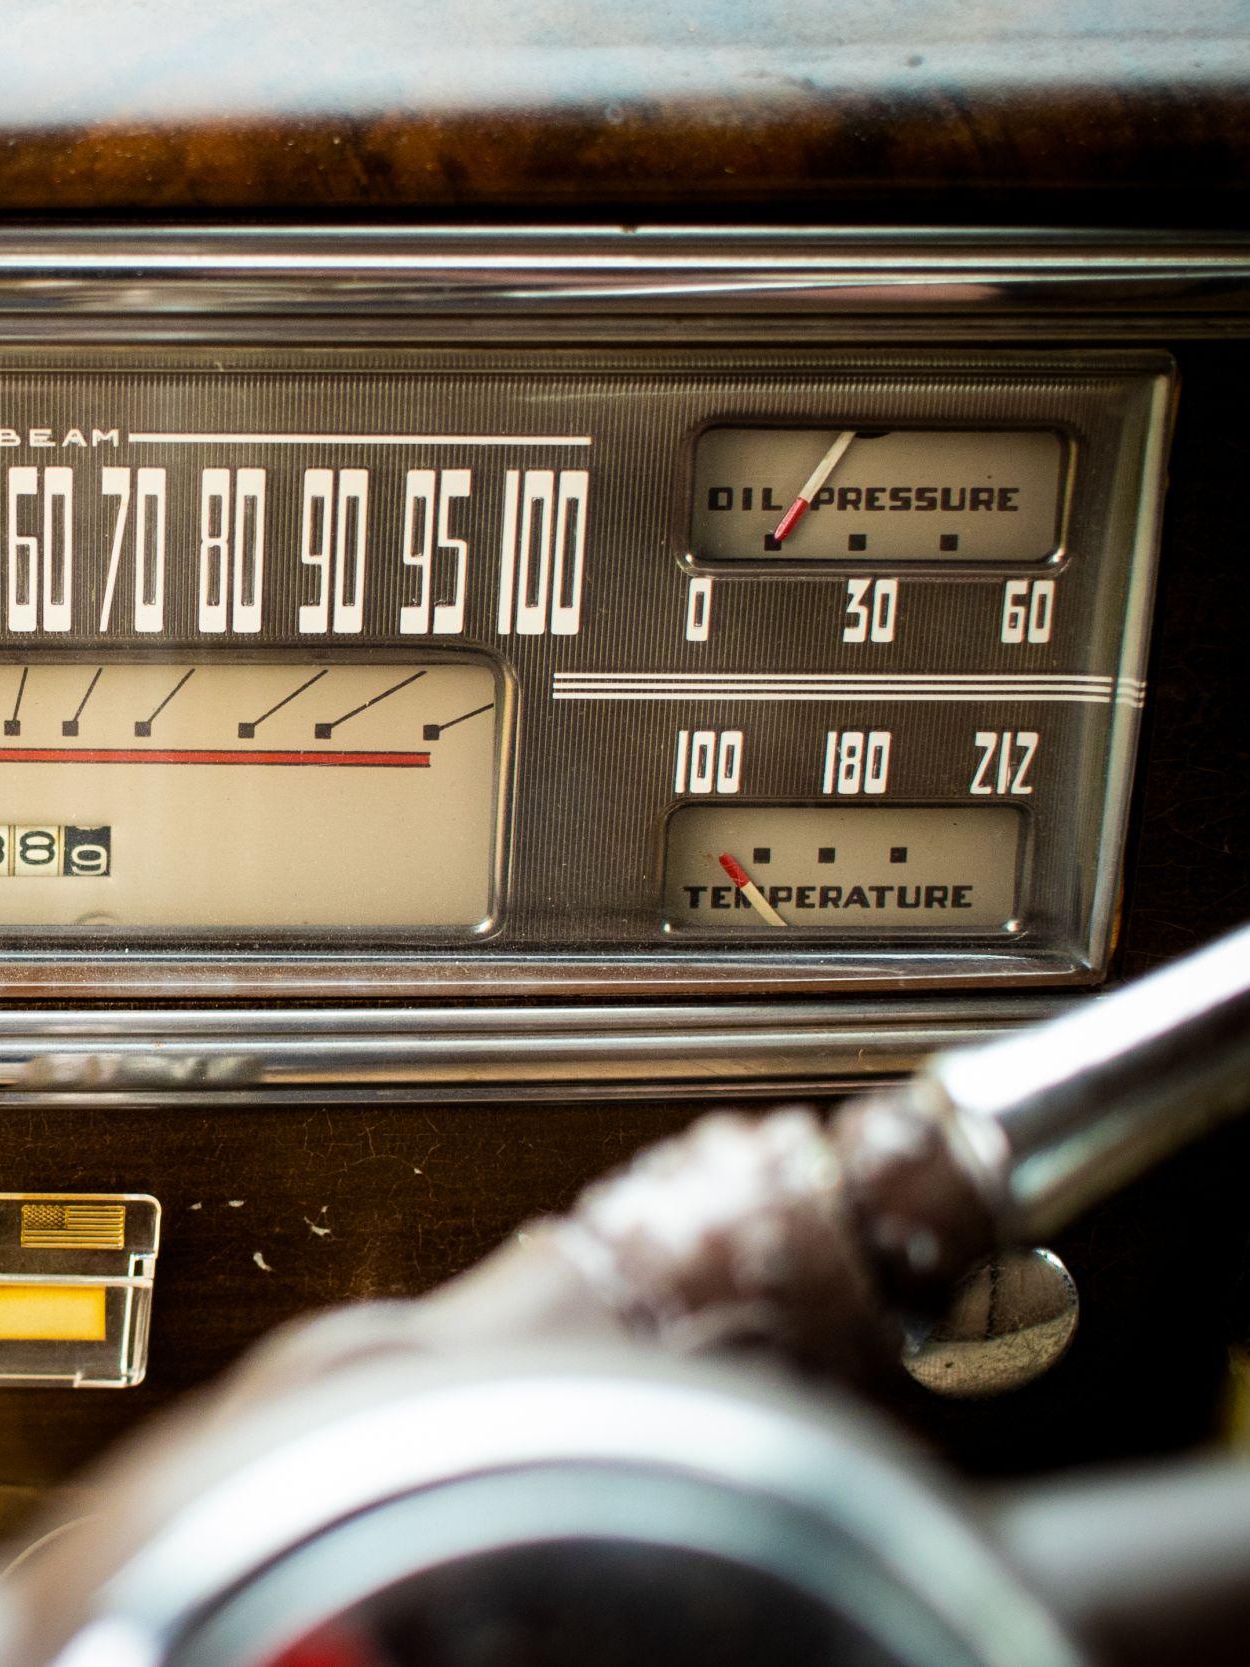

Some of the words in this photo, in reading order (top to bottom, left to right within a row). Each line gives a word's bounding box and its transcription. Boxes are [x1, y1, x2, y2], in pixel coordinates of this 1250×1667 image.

[707, 486, 783, 512] OIL
[809, 486, 1020, 512] PRESSURE
[8, 466, 73, 632] 60
[99, 467, 166, 632] 70
[199, 467, 266, 633] 80
[299, 468, 370, 634] 90
[399, 469, 472, 634] 95
[497, 469, 590, 635] 100
[686, 578, 712, 642] 0
[842, 578, 898, 643] 30
[1001, 579, 1055, 643] 60
[675, 730, 743, 794] 100
[822, 731, 892, 795] 180
[970, 731, 1040, 795] 212
